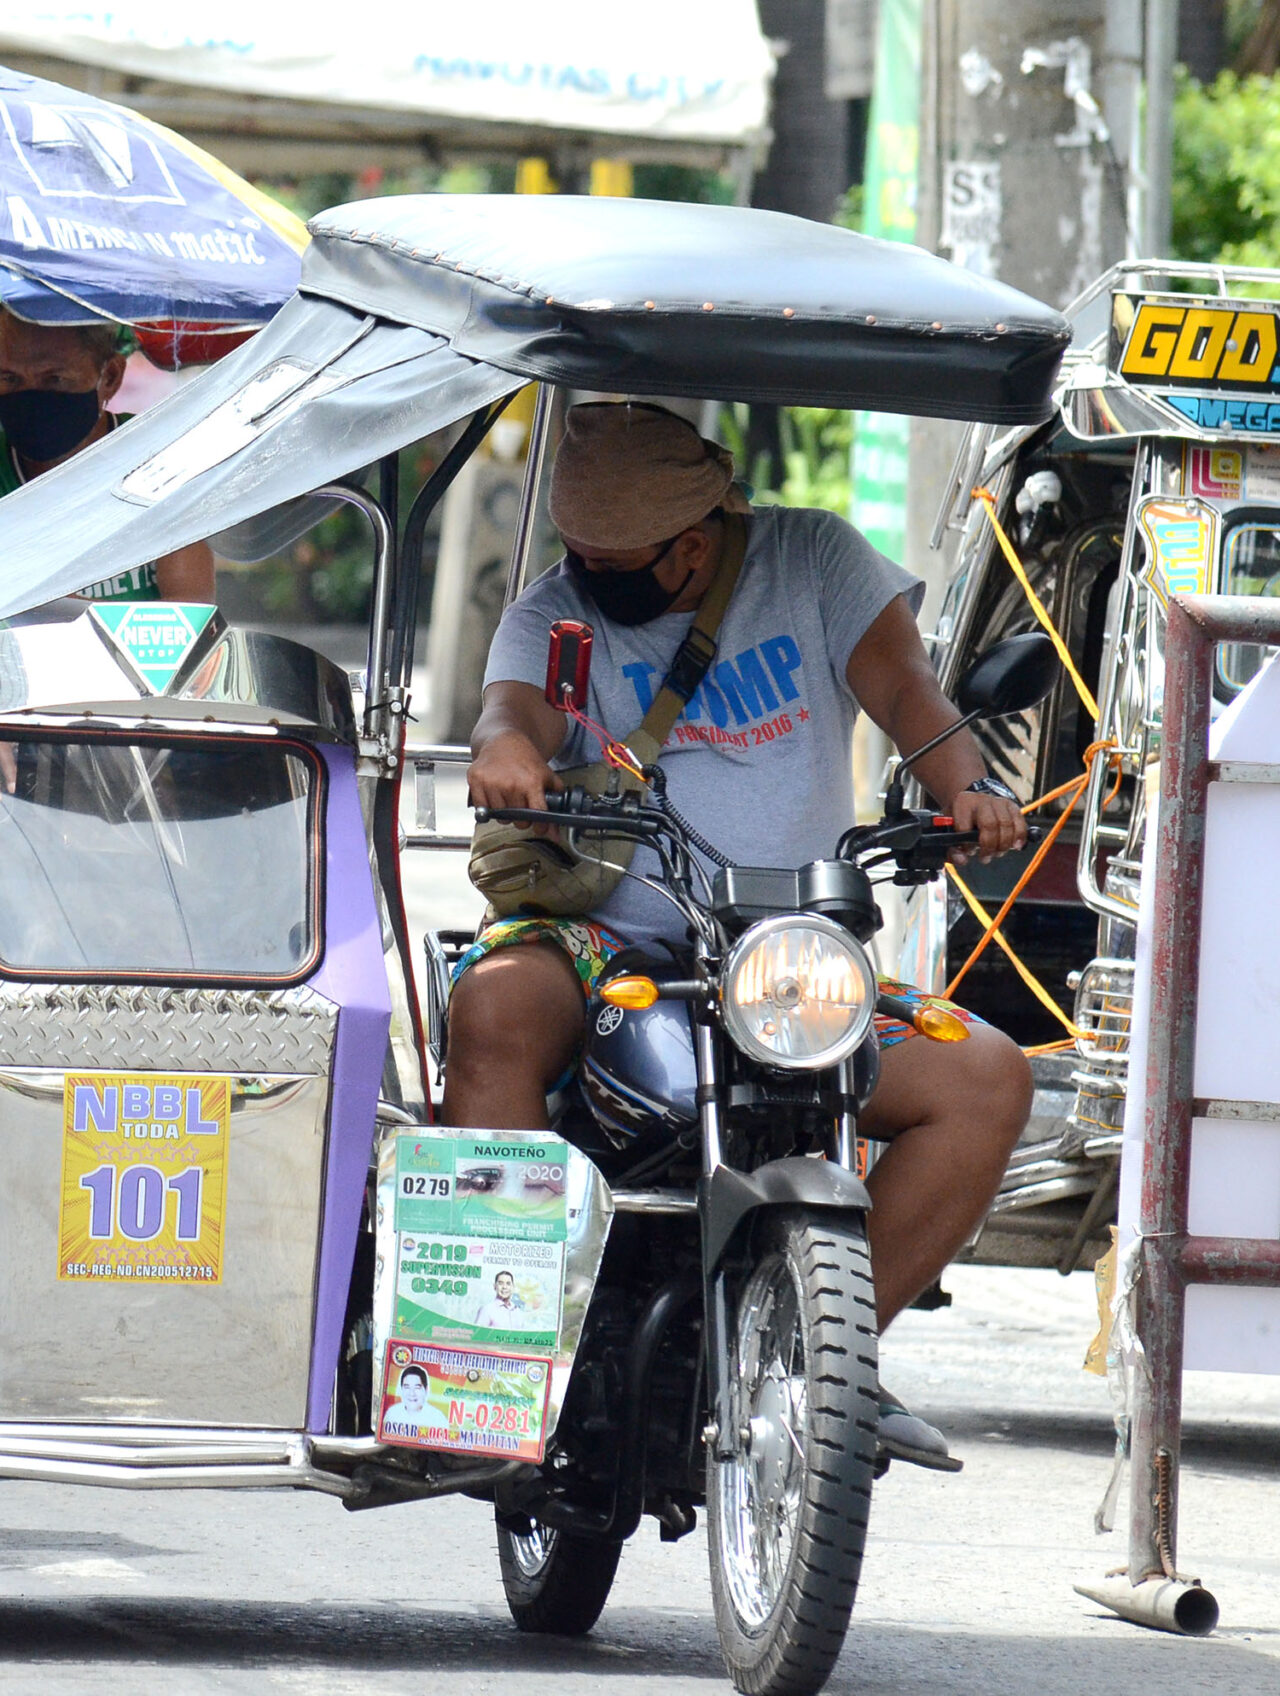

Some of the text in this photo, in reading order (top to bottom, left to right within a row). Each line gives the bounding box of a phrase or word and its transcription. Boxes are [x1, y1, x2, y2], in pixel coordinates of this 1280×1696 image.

[124, 625, 188, 646] NEVER
[622, 634, 802, 730] TUMP
[750, 713, 794, 746] 2016
[73, 1085, 219, 1135] NBBL
[122, 1122, 180, 1140] TODA
[474, 1145, 546, 1158] NAVOTEÑO
[519, 1165, 564, 1181] 2020
[403, 1177, 450, 1196] 0279
[79, 1164, 203, 1241] 101
[417, 1242, 468, 1262] 2019
[489, 1242, 554, 1259] MOTORIZED
[401, 1261, 482, 1279] SUPERVISION
[411, 1277, 468, 1297] 0349
[448, 1400, 530, 1433] N-0281
[385, 1421, 418, 1438] OSCAR
[460, 1430, 520, 1450] MALAPITAN
